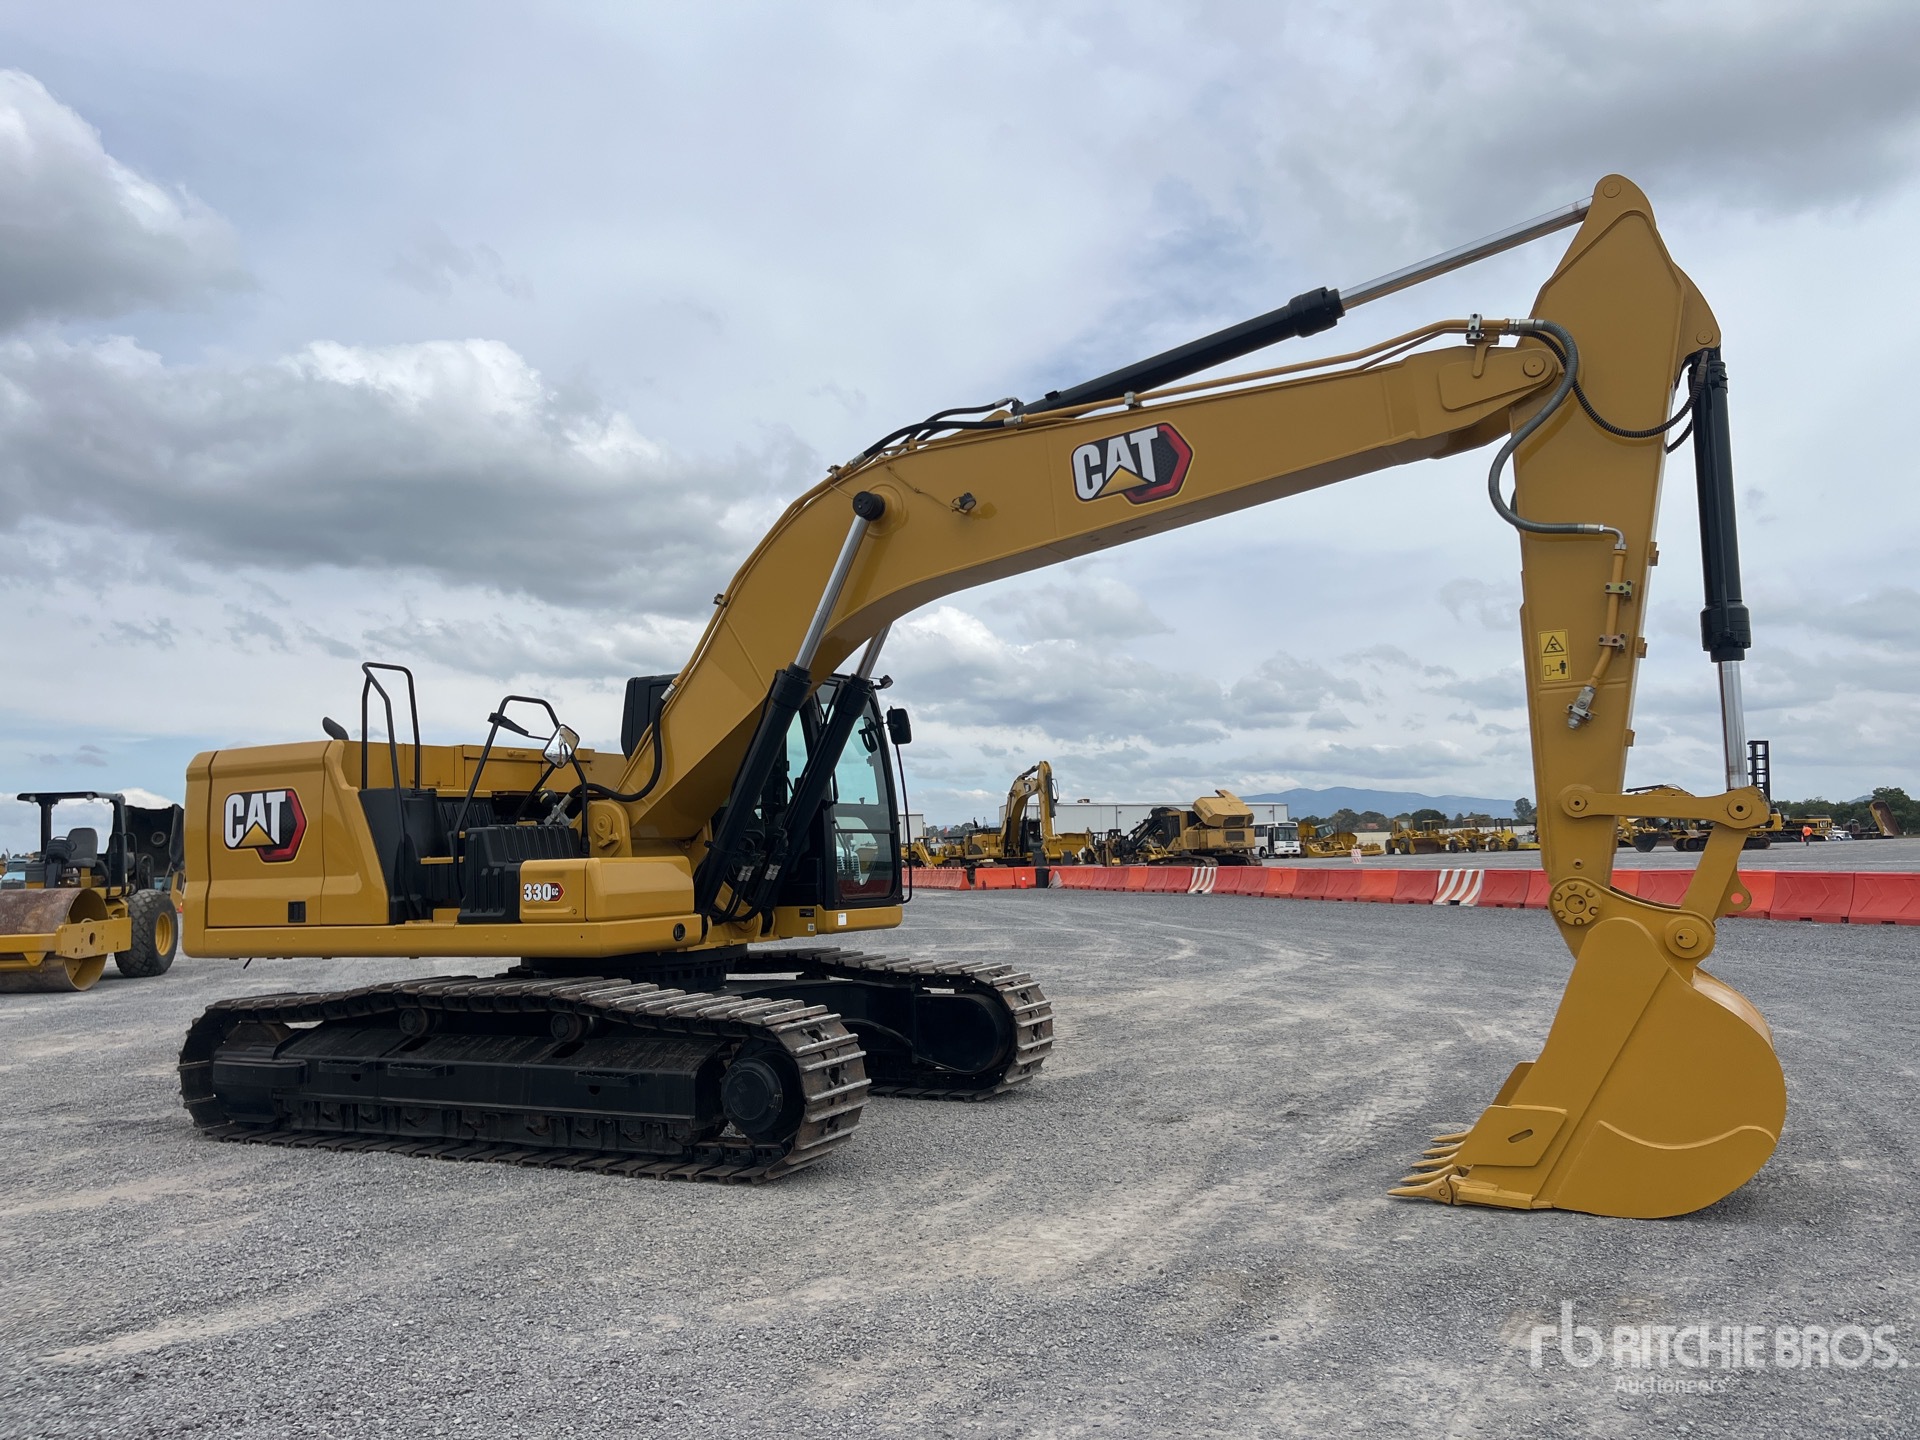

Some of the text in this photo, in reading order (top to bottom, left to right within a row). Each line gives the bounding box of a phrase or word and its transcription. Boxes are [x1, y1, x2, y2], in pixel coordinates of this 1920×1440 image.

[1072, 426, 1159, 500] CAT
[225, 790, 286, 848] CAT
[523, 883, 552, 902] 330
